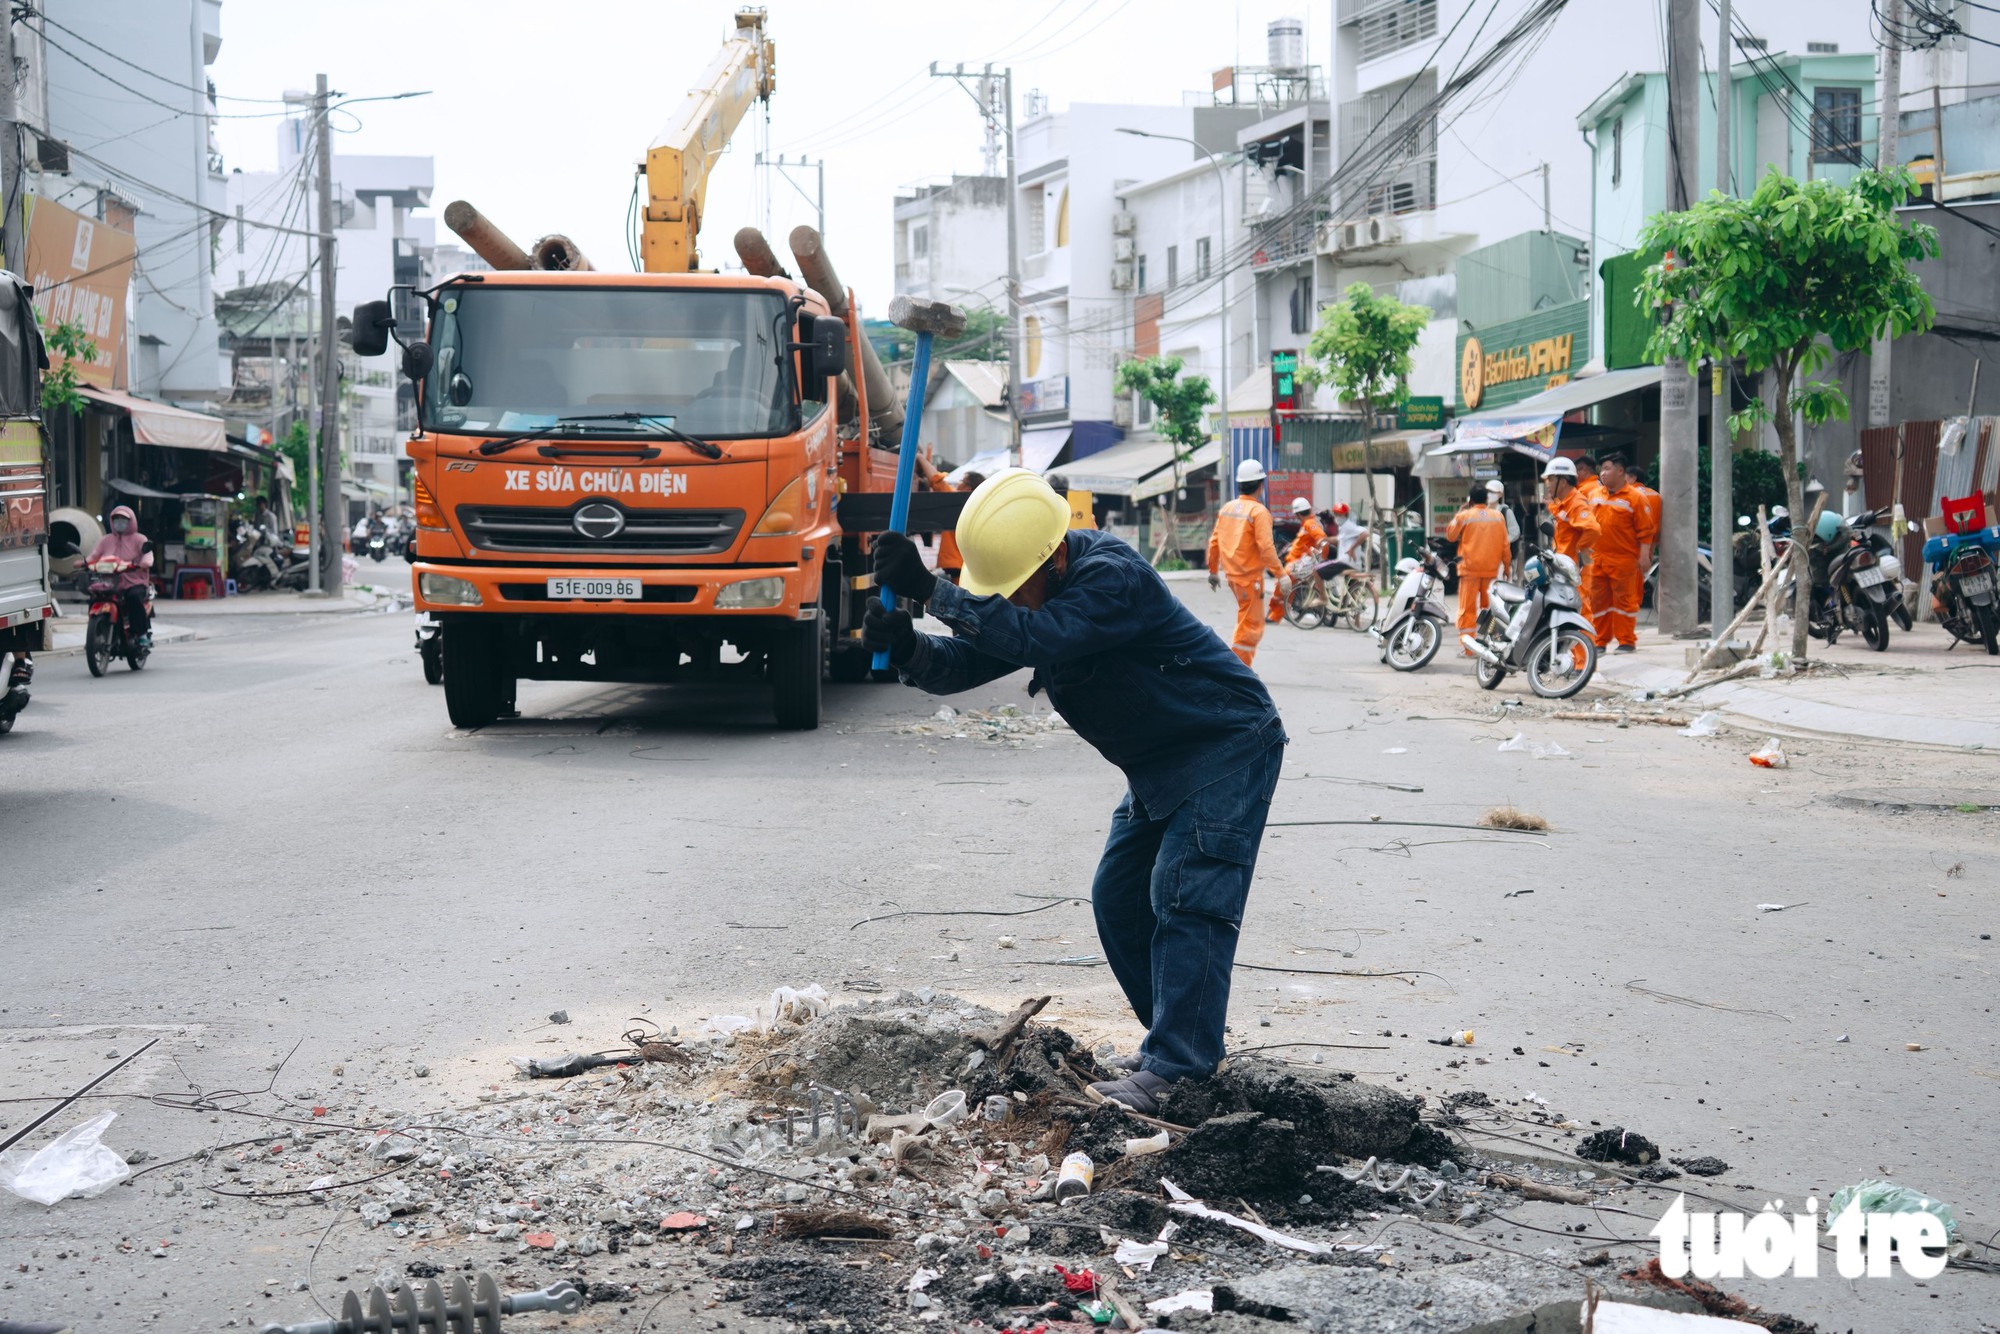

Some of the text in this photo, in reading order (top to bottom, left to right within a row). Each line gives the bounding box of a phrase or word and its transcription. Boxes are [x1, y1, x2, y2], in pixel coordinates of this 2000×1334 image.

[1526, 333, 1573, 378] XANH
[505, 465, 687, 497] XE SỬA CHỮA ĐIỆN
[555, 582, 634, 596] 51E-009.86
